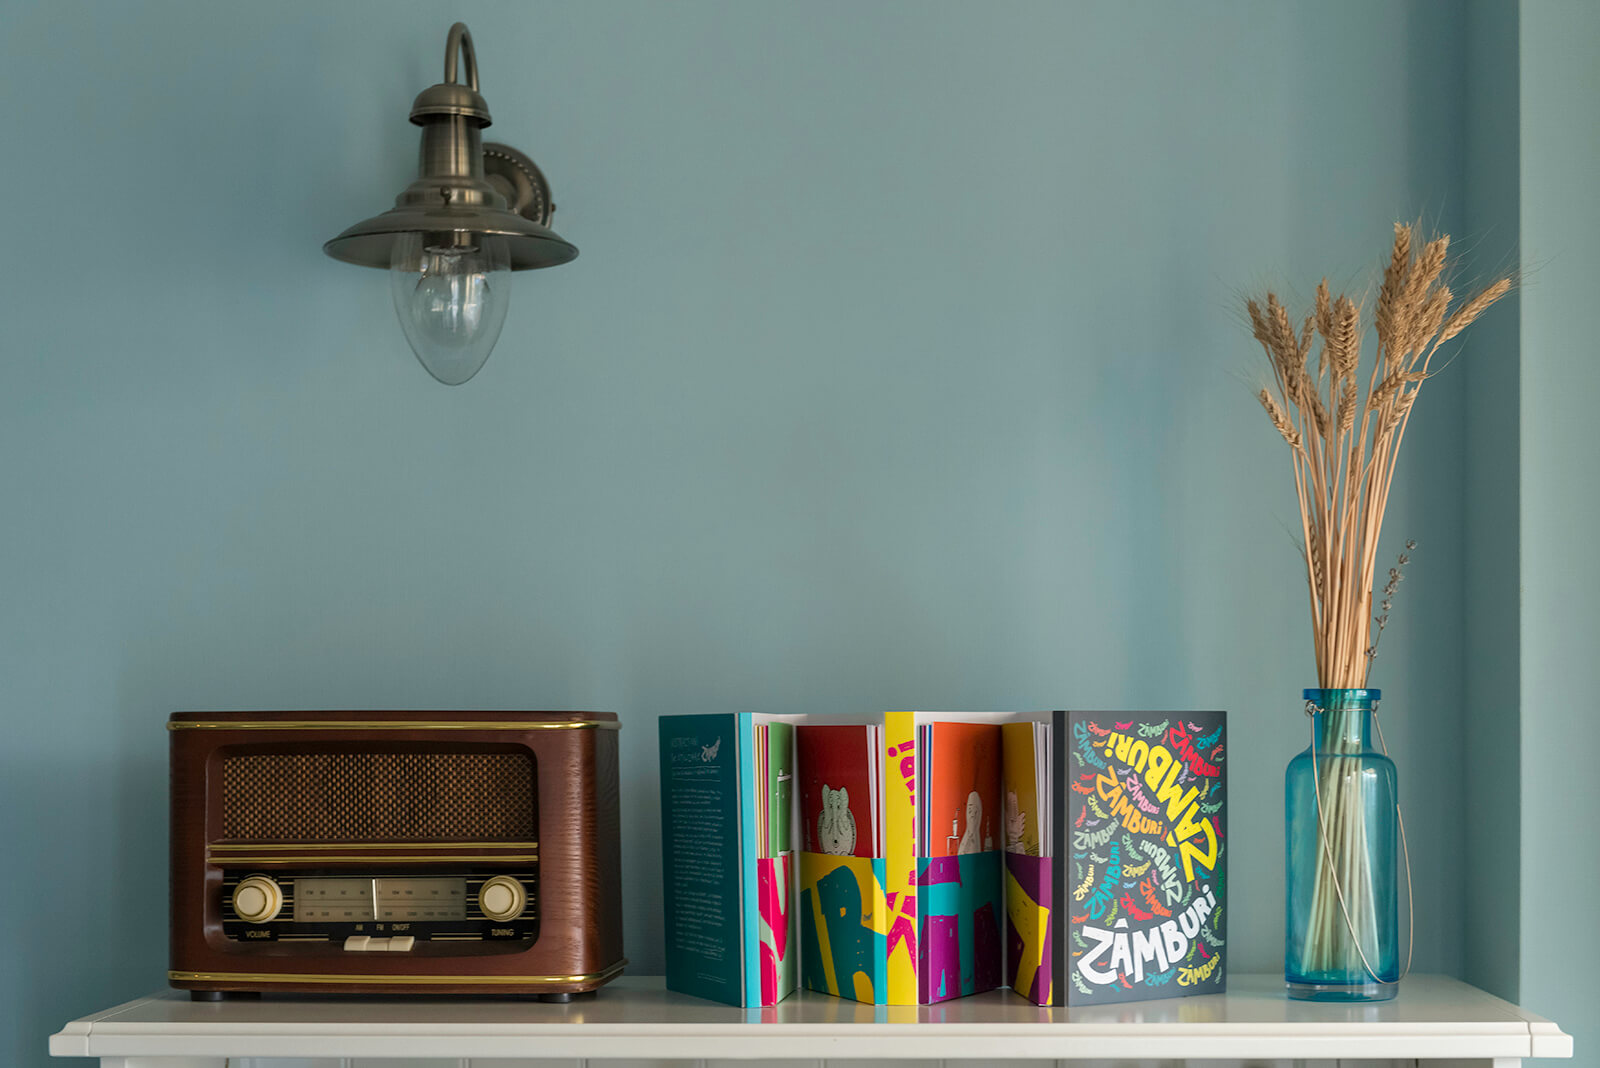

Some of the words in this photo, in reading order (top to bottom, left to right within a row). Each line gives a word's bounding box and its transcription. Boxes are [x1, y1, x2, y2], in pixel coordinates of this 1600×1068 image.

[376, 923, 385, 931] FM
[245, 930, 271, 938] VOLUME
[491, 928, 515, 937] TUNING
